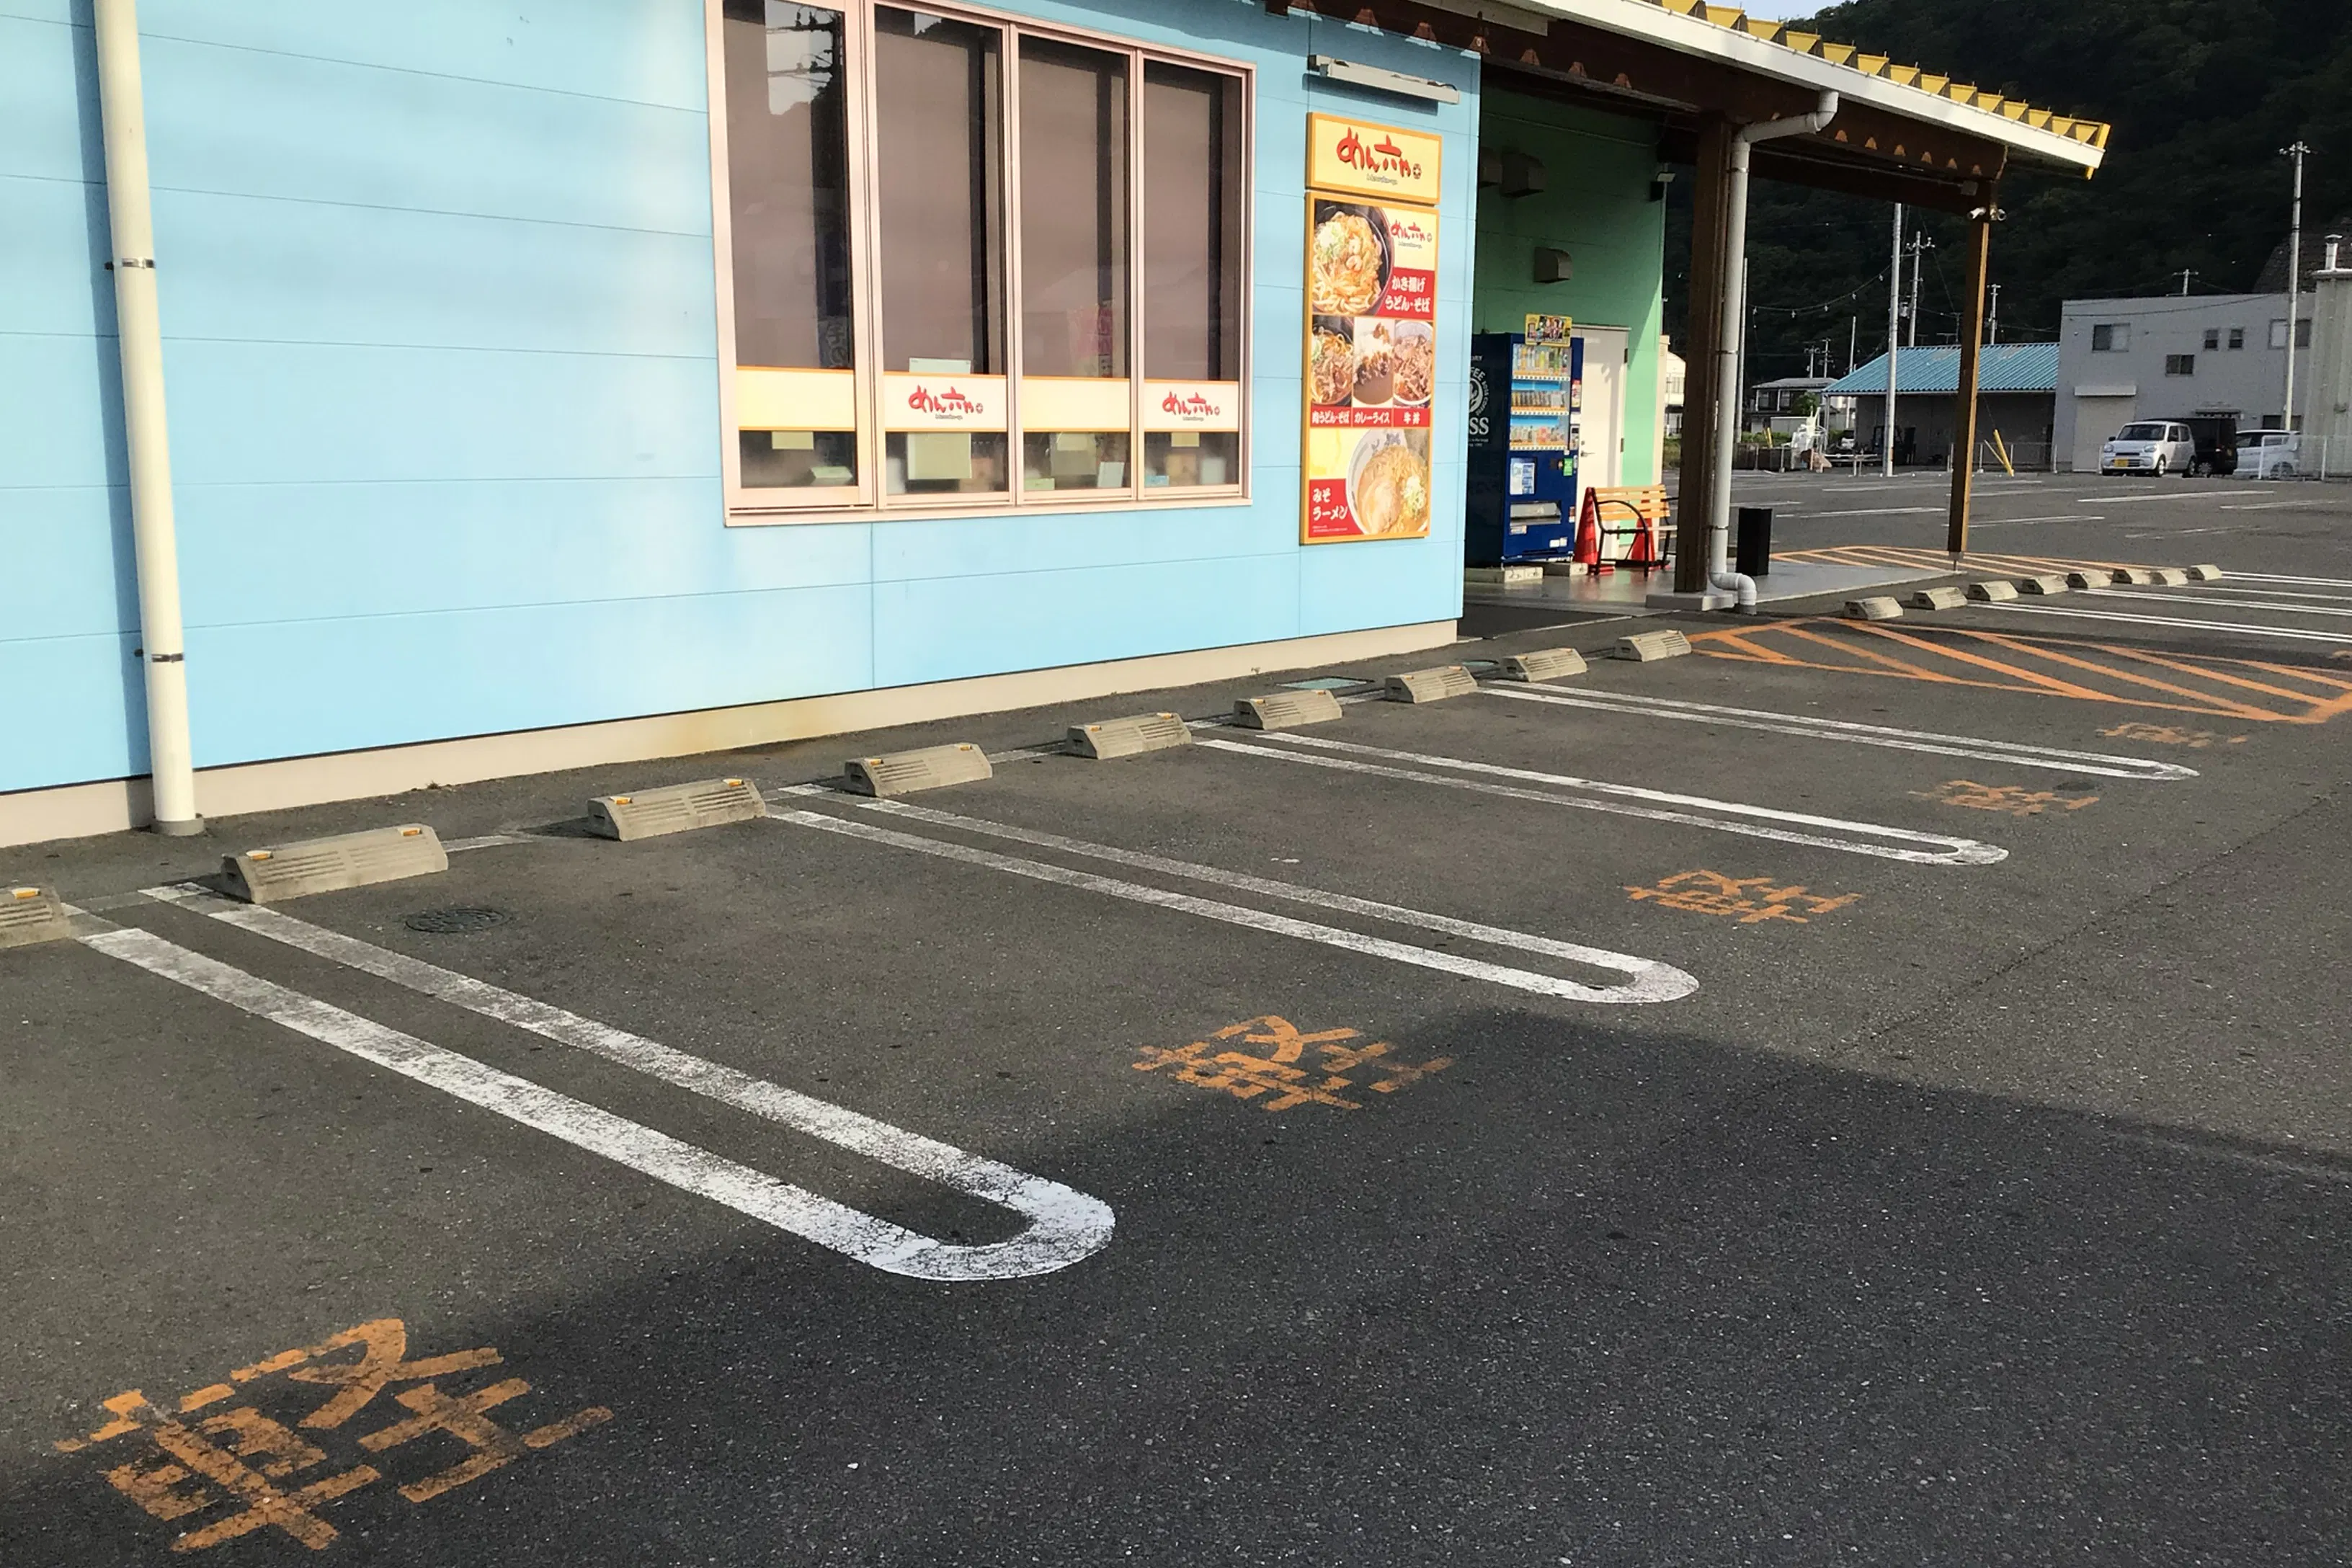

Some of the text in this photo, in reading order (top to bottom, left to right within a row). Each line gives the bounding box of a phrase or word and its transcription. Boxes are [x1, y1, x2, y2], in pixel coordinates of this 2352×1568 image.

[1391, 275, 1426, 293] かき揚げ
[1385, 294, 1431, 313] うどん・そば
[1354, 410, 1390, 424] カレーライス
[1403, 411, 1420, 424] 牛丼
[1312, 487, 1331, 503] みそ
[1312, 504, 1348, 522] ラーメン
